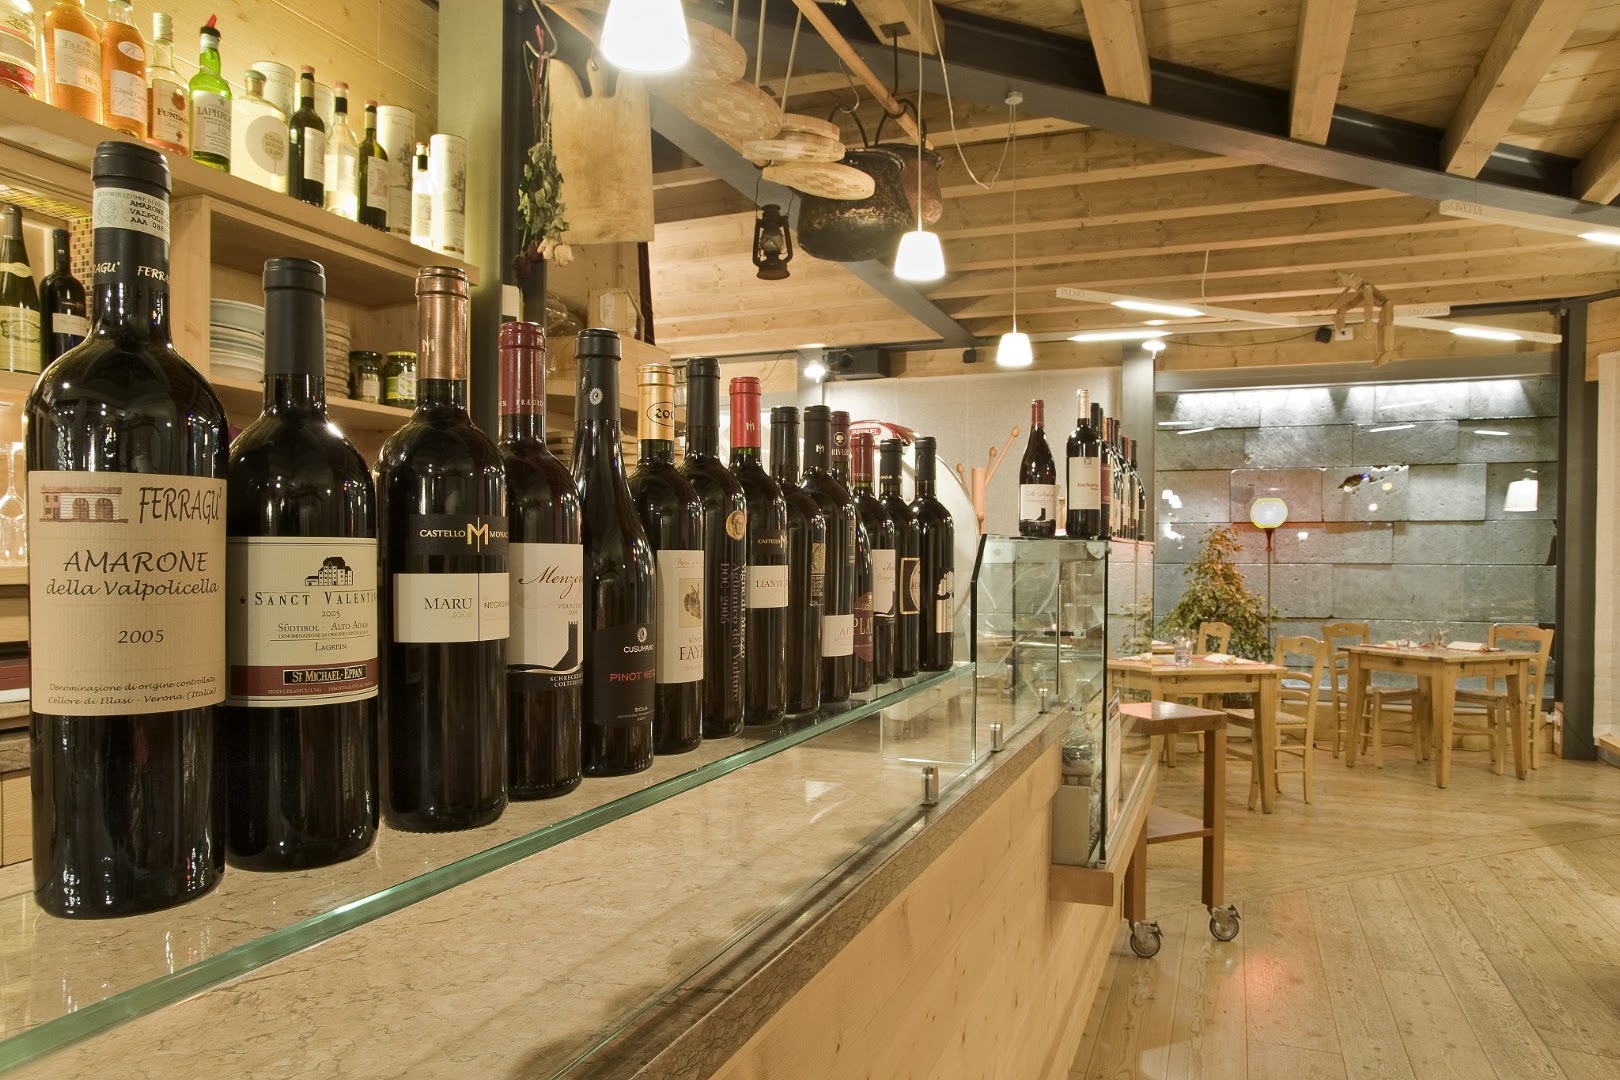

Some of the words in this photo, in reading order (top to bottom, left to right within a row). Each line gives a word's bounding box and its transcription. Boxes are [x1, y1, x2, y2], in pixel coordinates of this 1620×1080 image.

[130, 200, 164, 216] AMARONE
[130, 217, 148, 226] AAA
[419, 529, 466, 538] CASTELLO
[63, 549, 209, 574] AMARONE
[720, 563, 730, 589] DOC
[46, 578, 101, 595] della
[103, 578, 220, 601] Valpolicella
[729, 563, 741, 624] Aglianico
[255, 591, 311, 606] SANCT
[423, 597, 472, 610] MARU
[321, 610, 341, 619] 2005
[720, 597, 730, 625] 2005
[277, 622, 320, 632] SÜDTIROL
[330, 621, 351, 631] ALTO
[117, 629, 165, 644] 2005
[732, 626, 741, 649] del
[314, 642, 347, 651] LAGREIN
[304, 667, 363, 683] MICHAEL-EPPAN
[609, 671, 642, 682] PINOT
[731, 652, 741, 702] Vulture
[49, 682, 123, 694] Denominazione
[124, 681, 138, 692] di
[138, 680, 176, 691] origine
[48, 696, 83, 706] Cellore
[84, 696, 97, 706] di
[143, 693, 184, 704] Verona
[186, 687, 217, 701] (Italia)
